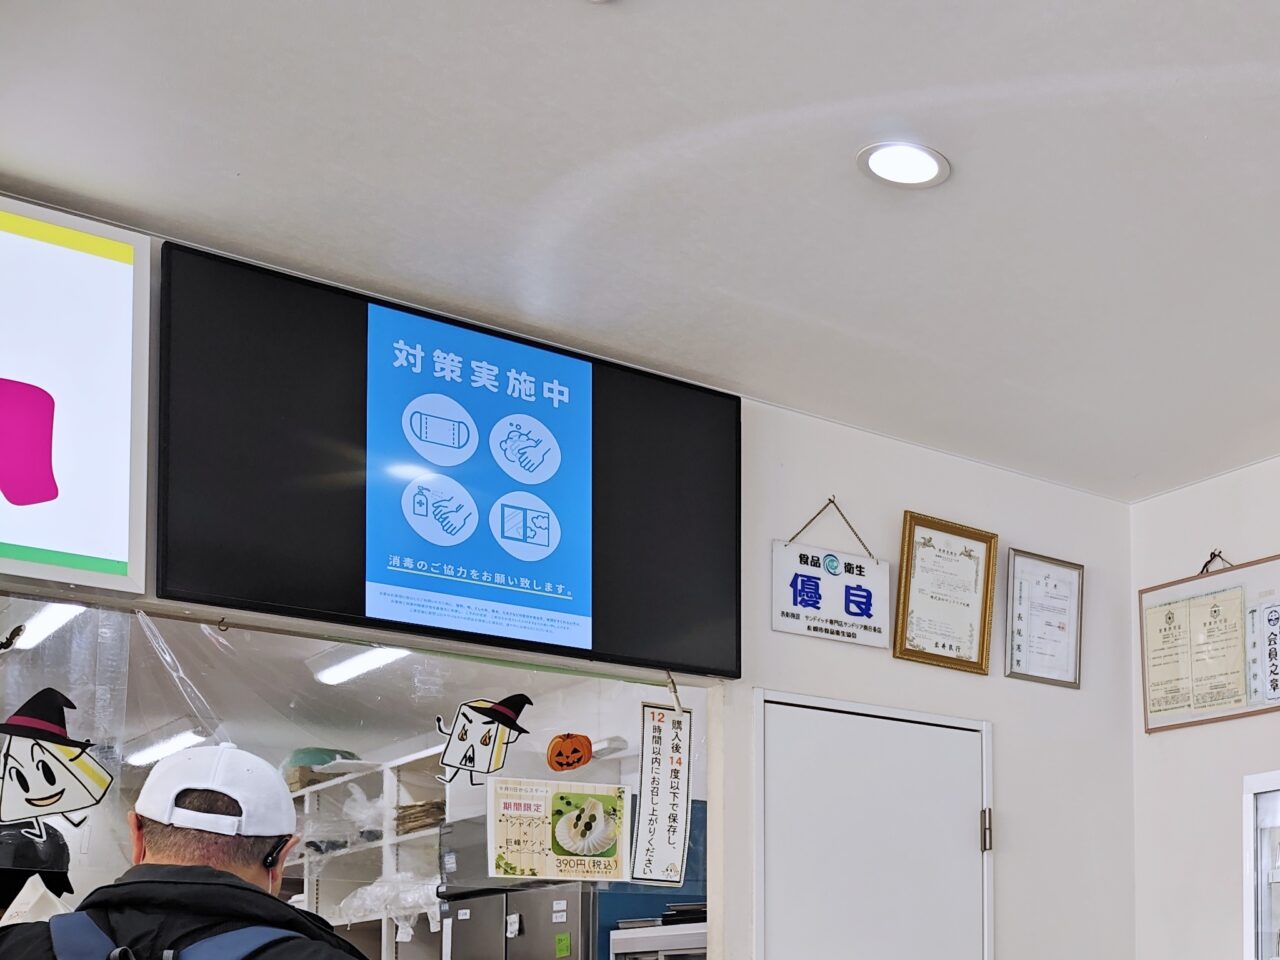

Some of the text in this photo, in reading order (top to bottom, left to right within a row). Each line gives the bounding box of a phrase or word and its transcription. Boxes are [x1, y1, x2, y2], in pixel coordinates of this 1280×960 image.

[392, 339, 570, 408] 対策実施中
[388, 554, 573, 596] 消毒のご協力をお願い致します。
[799, 553, 866, 577] 食品 衛生
[789, 573, 874, 619] 優 良
[1267, 631, 1279, 693] 会員之章
[503, 802, 542, 812] 期間限定
[510, 821, 541, 829] シャイン
[505, 838, 545, 847] 巨峰サンド
